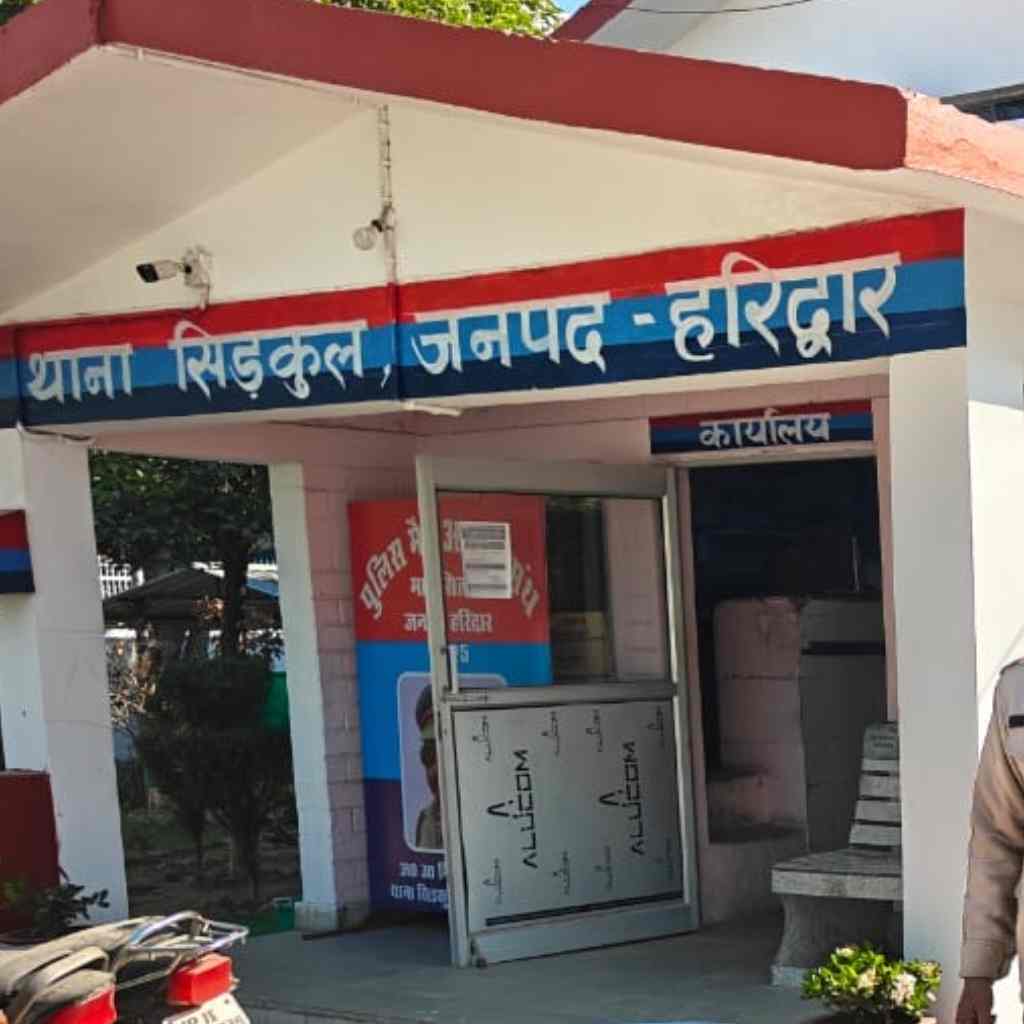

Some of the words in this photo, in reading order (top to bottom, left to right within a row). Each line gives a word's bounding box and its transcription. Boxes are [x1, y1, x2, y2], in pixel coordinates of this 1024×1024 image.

[29, 343, 133, 403] थाना
[410, 290, 612, 375] जनपद
[664, 251, 902, 362] हरिद्वार
[699, 408, 832, 451] कार्यालय
[360, 537, 408, 620] पुलिस
